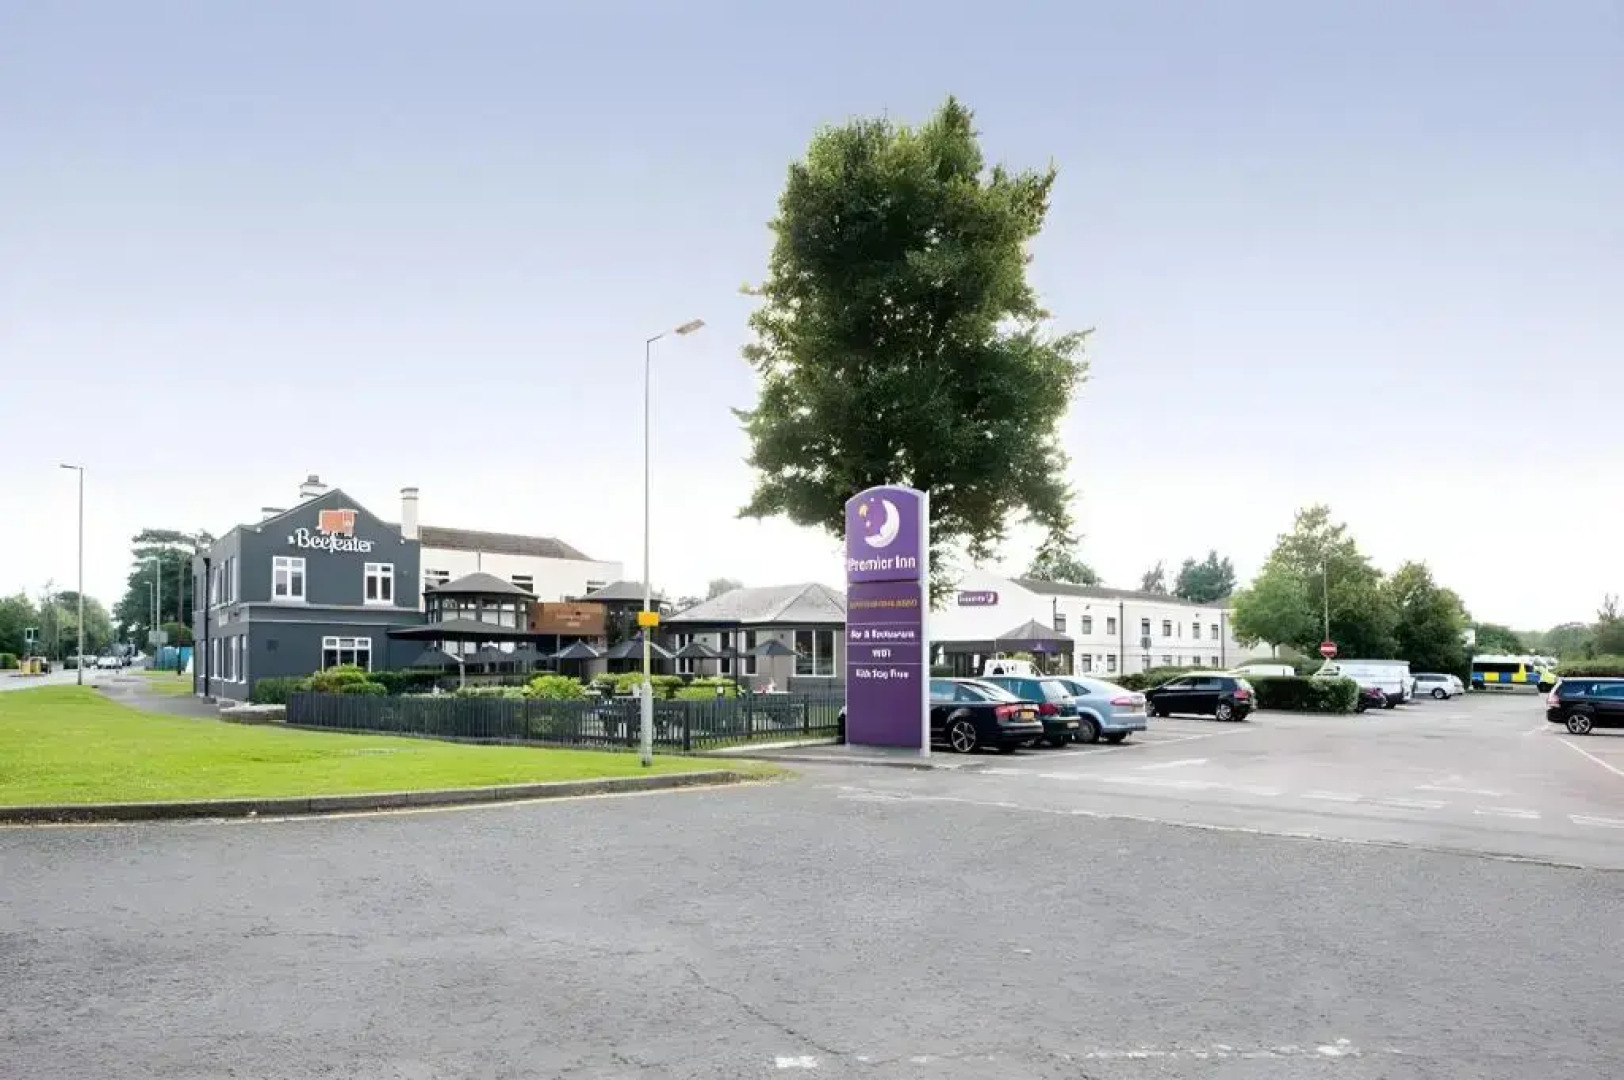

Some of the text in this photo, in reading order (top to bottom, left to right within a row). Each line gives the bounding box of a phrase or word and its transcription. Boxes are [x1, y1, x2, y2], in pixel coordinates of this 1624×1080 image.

[296, 528, 375, 554] Beefeater
[848, 555, 916, 572] Premier Inn
